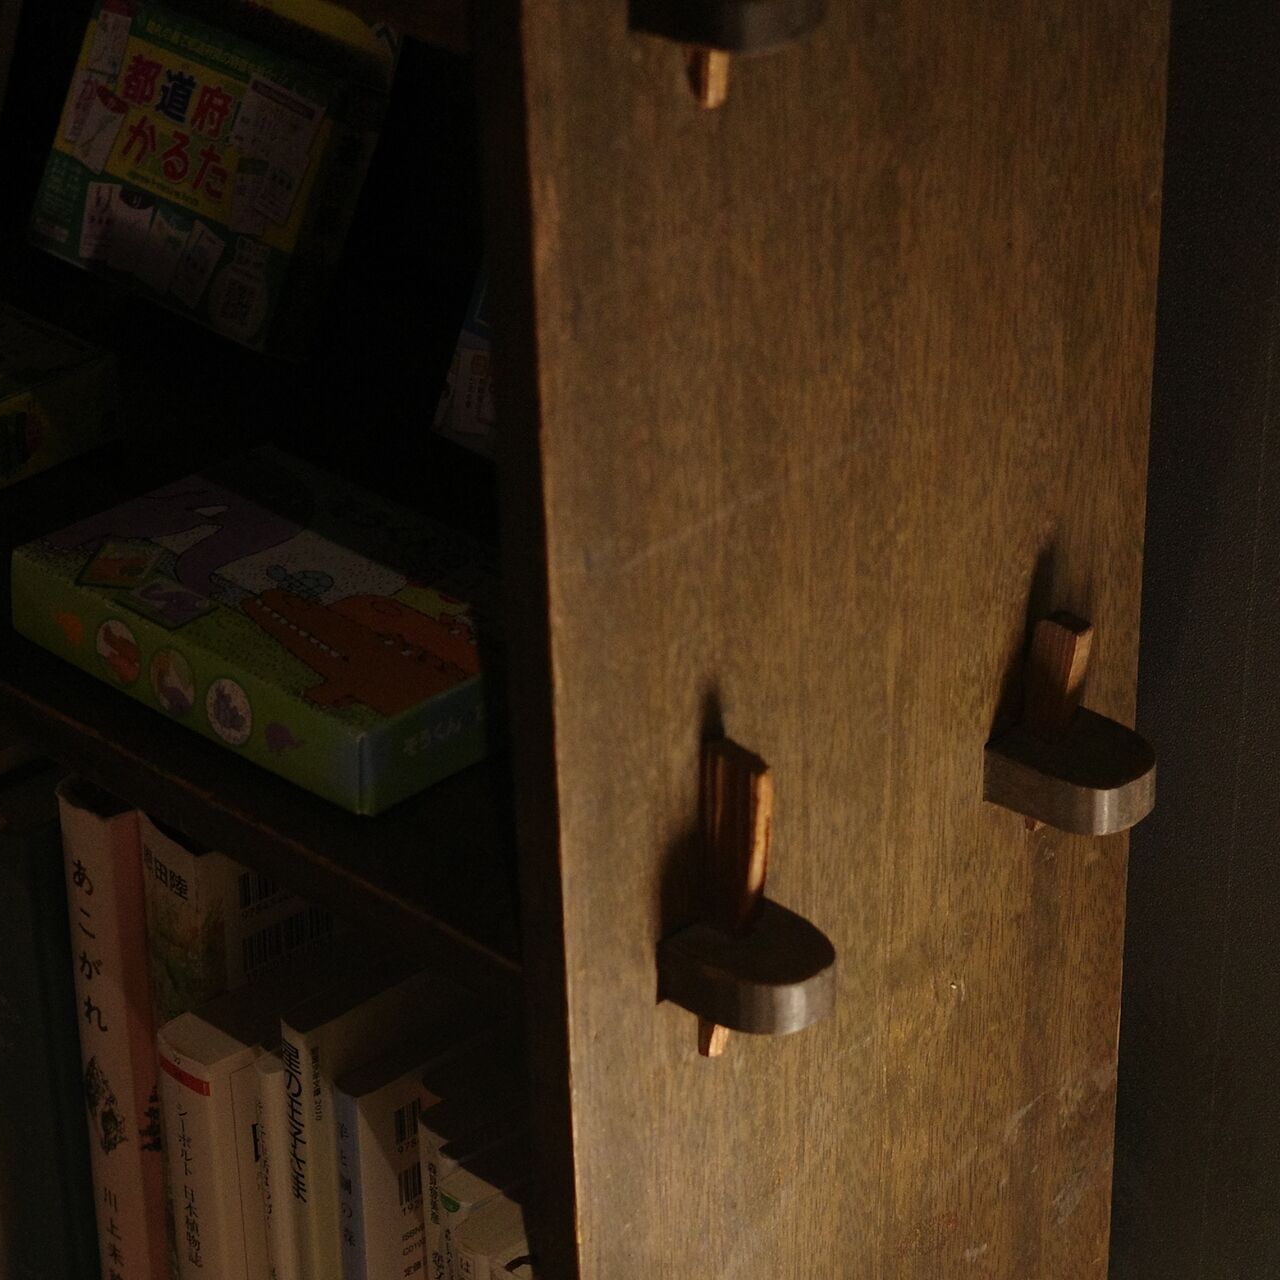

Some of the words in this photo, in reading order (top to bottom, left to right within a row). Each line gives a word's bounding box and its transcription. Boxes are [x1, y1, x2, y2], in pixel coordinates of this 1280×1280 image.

[122, 53, 239, 141] 都道府
[122, 113, 229, 201] かるた
[70, 858, 108, 1034] あこがれ
[175, 1102, 195, 1177] シーボルト
[184, 1185, 204, 1268] 日本植物誌
